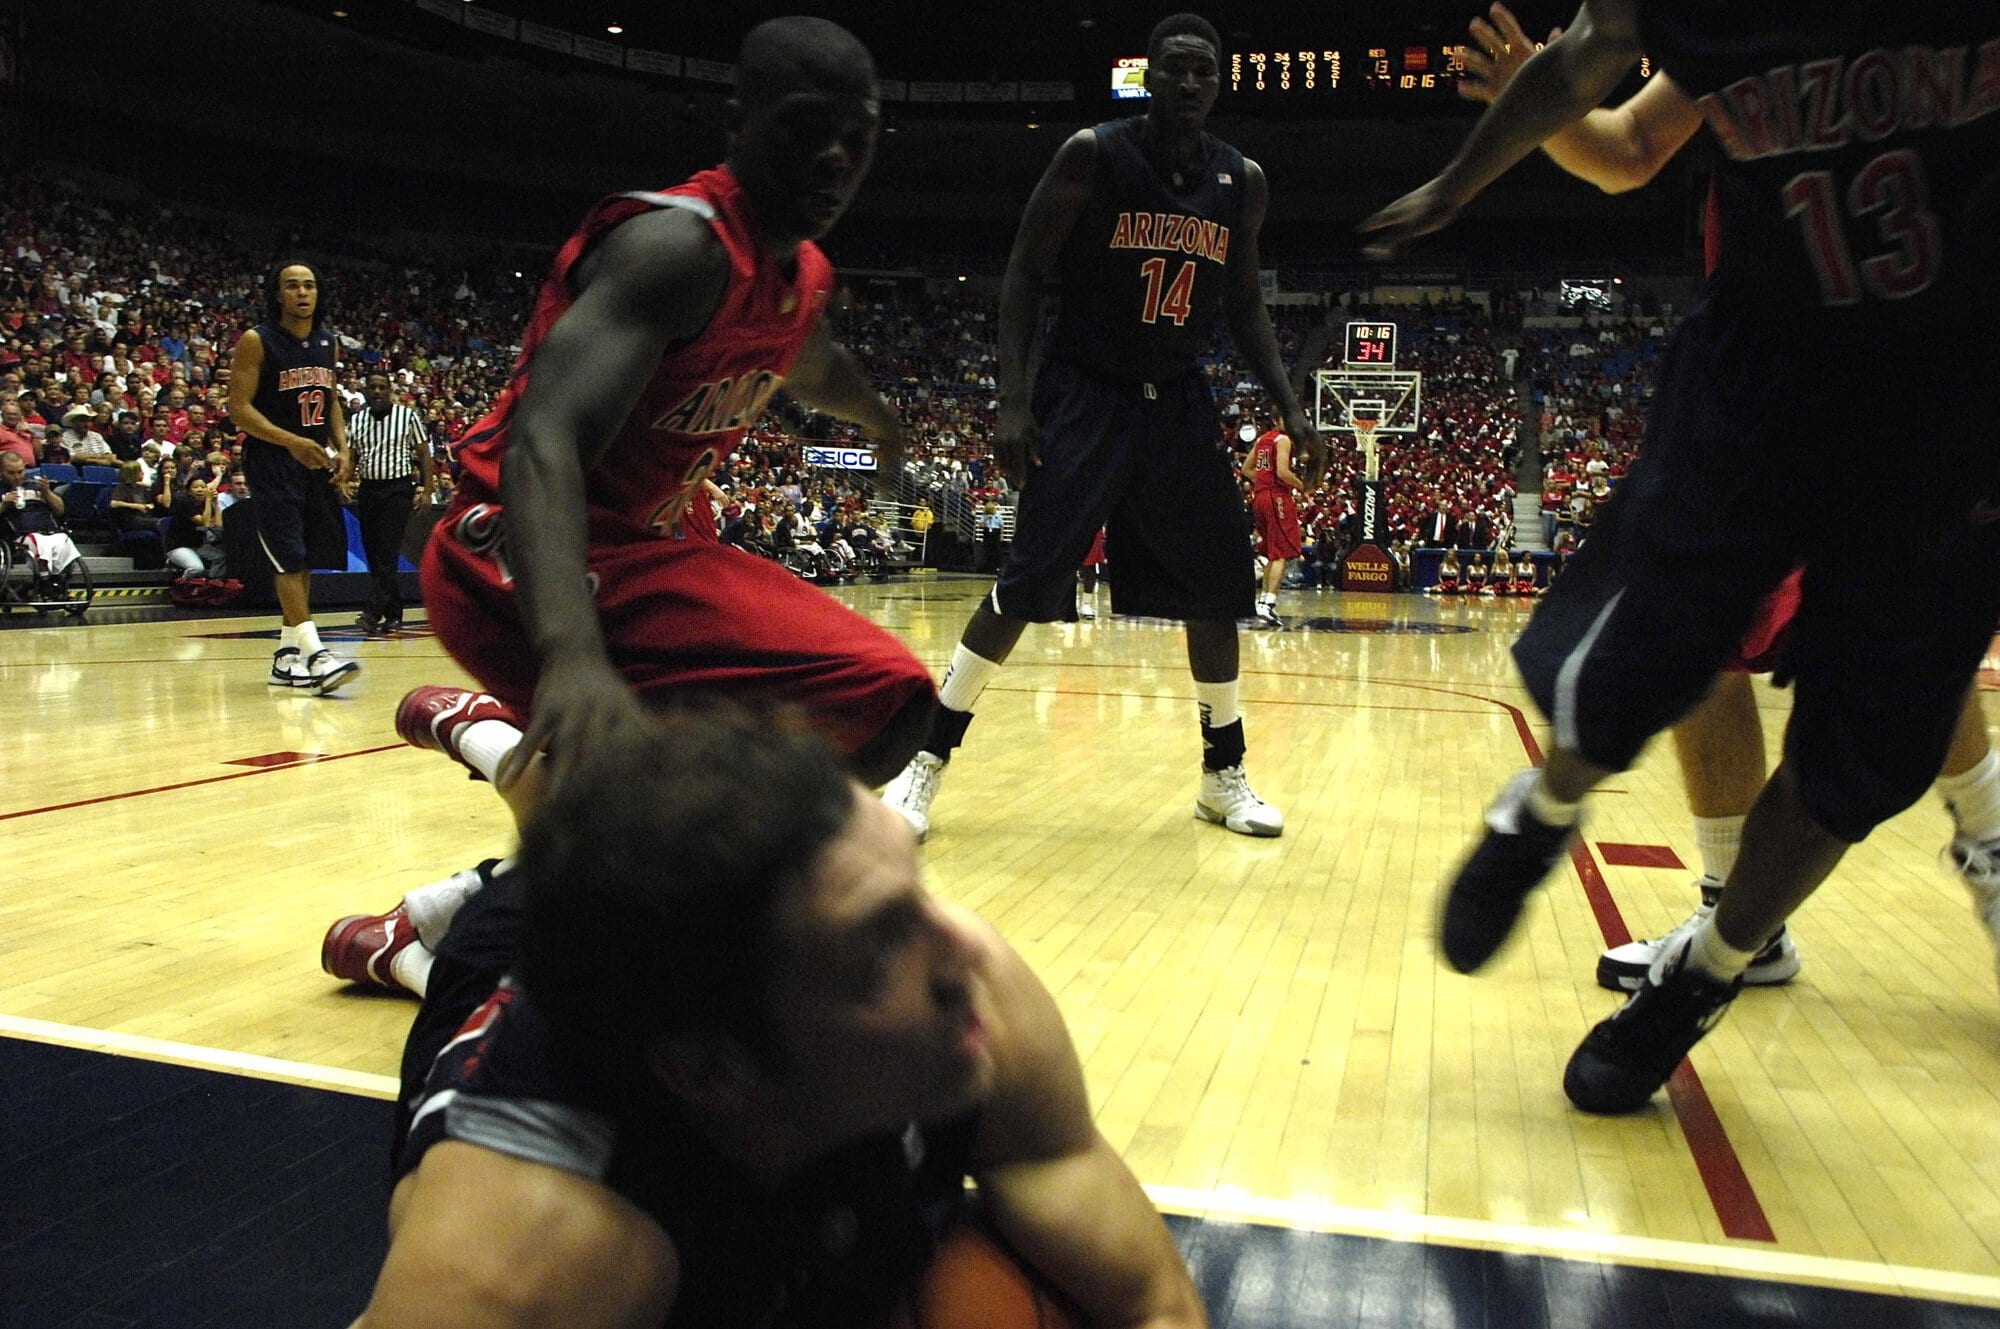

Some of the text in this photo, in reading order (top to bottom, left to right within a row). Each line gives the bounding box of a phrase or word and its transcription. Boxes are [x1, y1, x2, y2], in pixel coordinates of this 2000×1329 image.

[1249, 53, 1266, 63] 20
[1273, 52, 1290, 62] 34
[1298, 51, 1315, 61] 50
[1323, 50, 1340, 60] 54
[1400, 73, 1436, 89] 10:16
[1782, 149, 1942, 305] 13
[1109, 211, 1230, 266] ARIZONA
[1140, 256, 1197, 327] 14
[1356, 326, 1391, 339] 10:16
[1357, 341, 1385, 361] 34
[297, 389, 325, 427] 12
[805, 449, 876, 466] GEICO
[1363, 484, 1376, 540] ARIZONA
[1346, 561, 1389, 572] WELLS
[1347, 572, 1388, 581] FARGO
